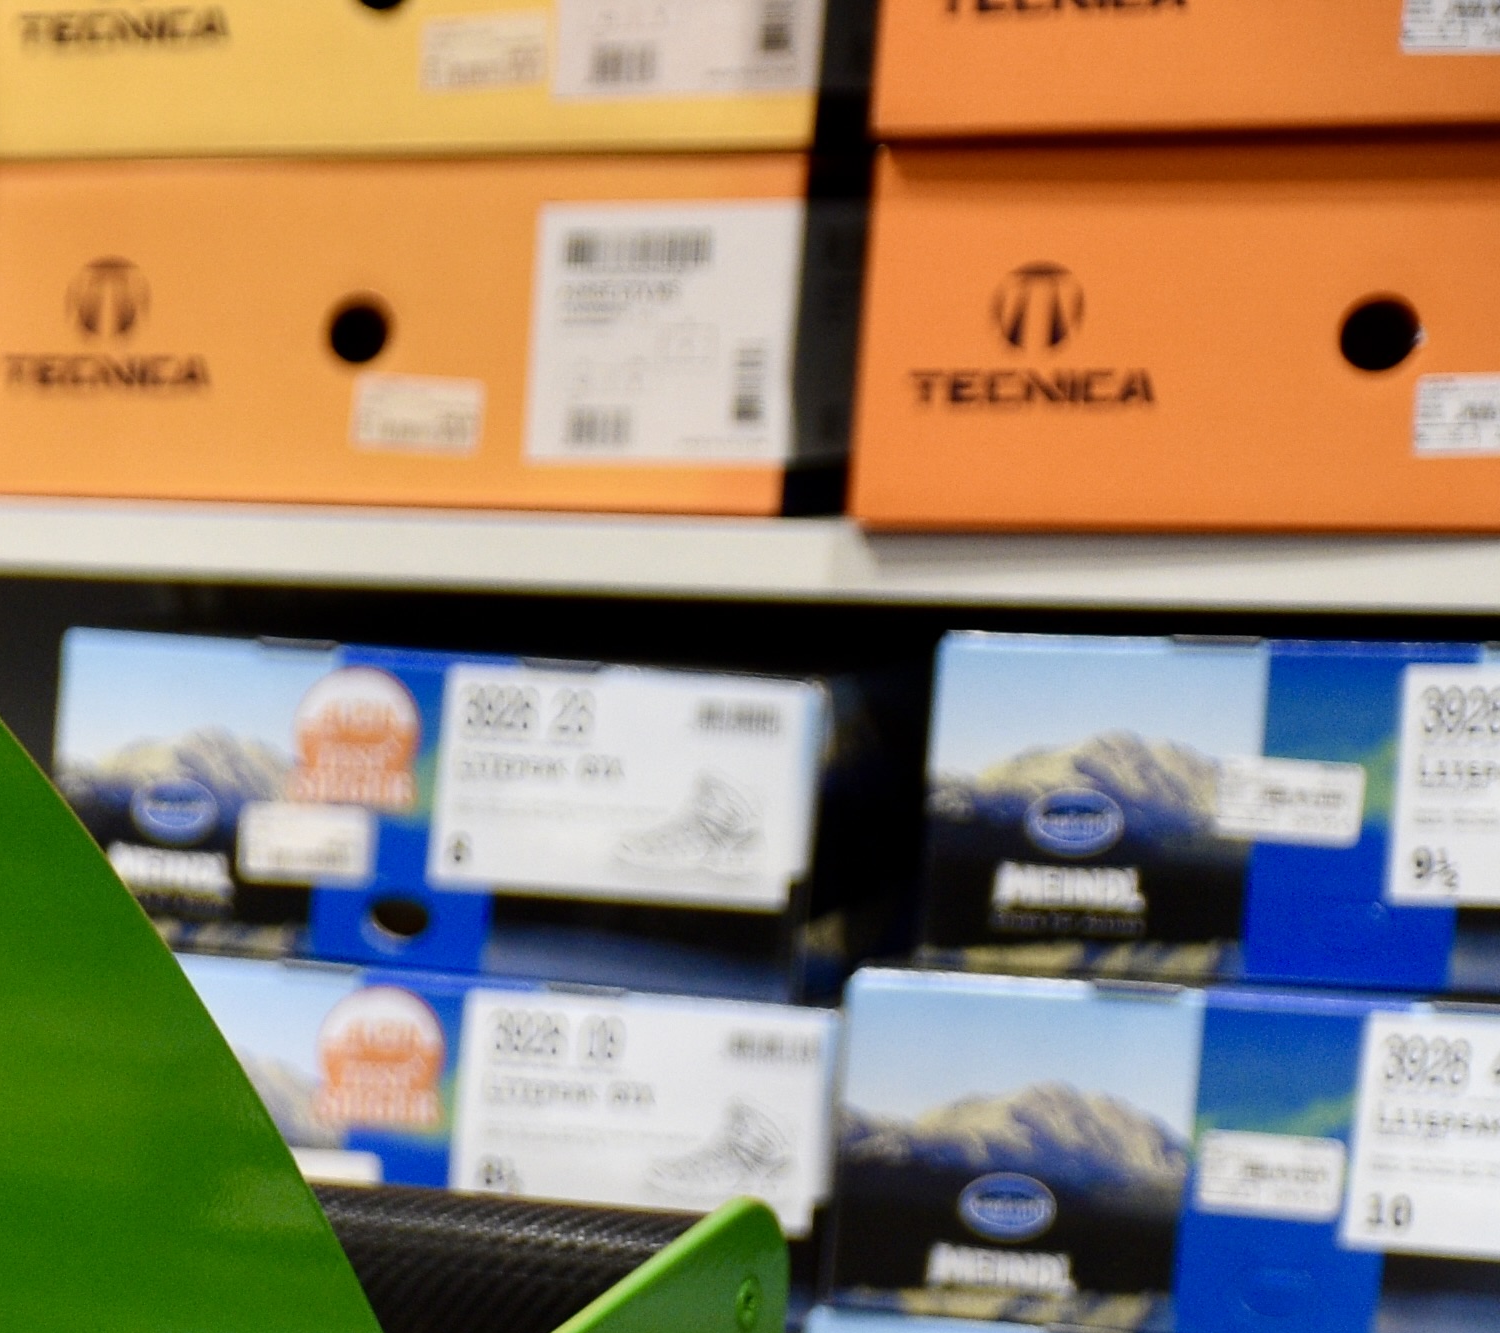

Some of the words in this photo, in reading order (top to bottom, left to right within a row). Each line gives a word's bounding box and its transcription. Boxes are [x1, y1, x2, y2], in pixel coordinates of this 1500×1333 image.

[19, 8, 232, 50] TECNICA
[5, 354, 212, 390] TECNICA
[908, 368, 1158, 408] TECNICA
[991, 858, 1148, 914] MEINDL
[925, 1240, 1079, 1296] MEINDL
